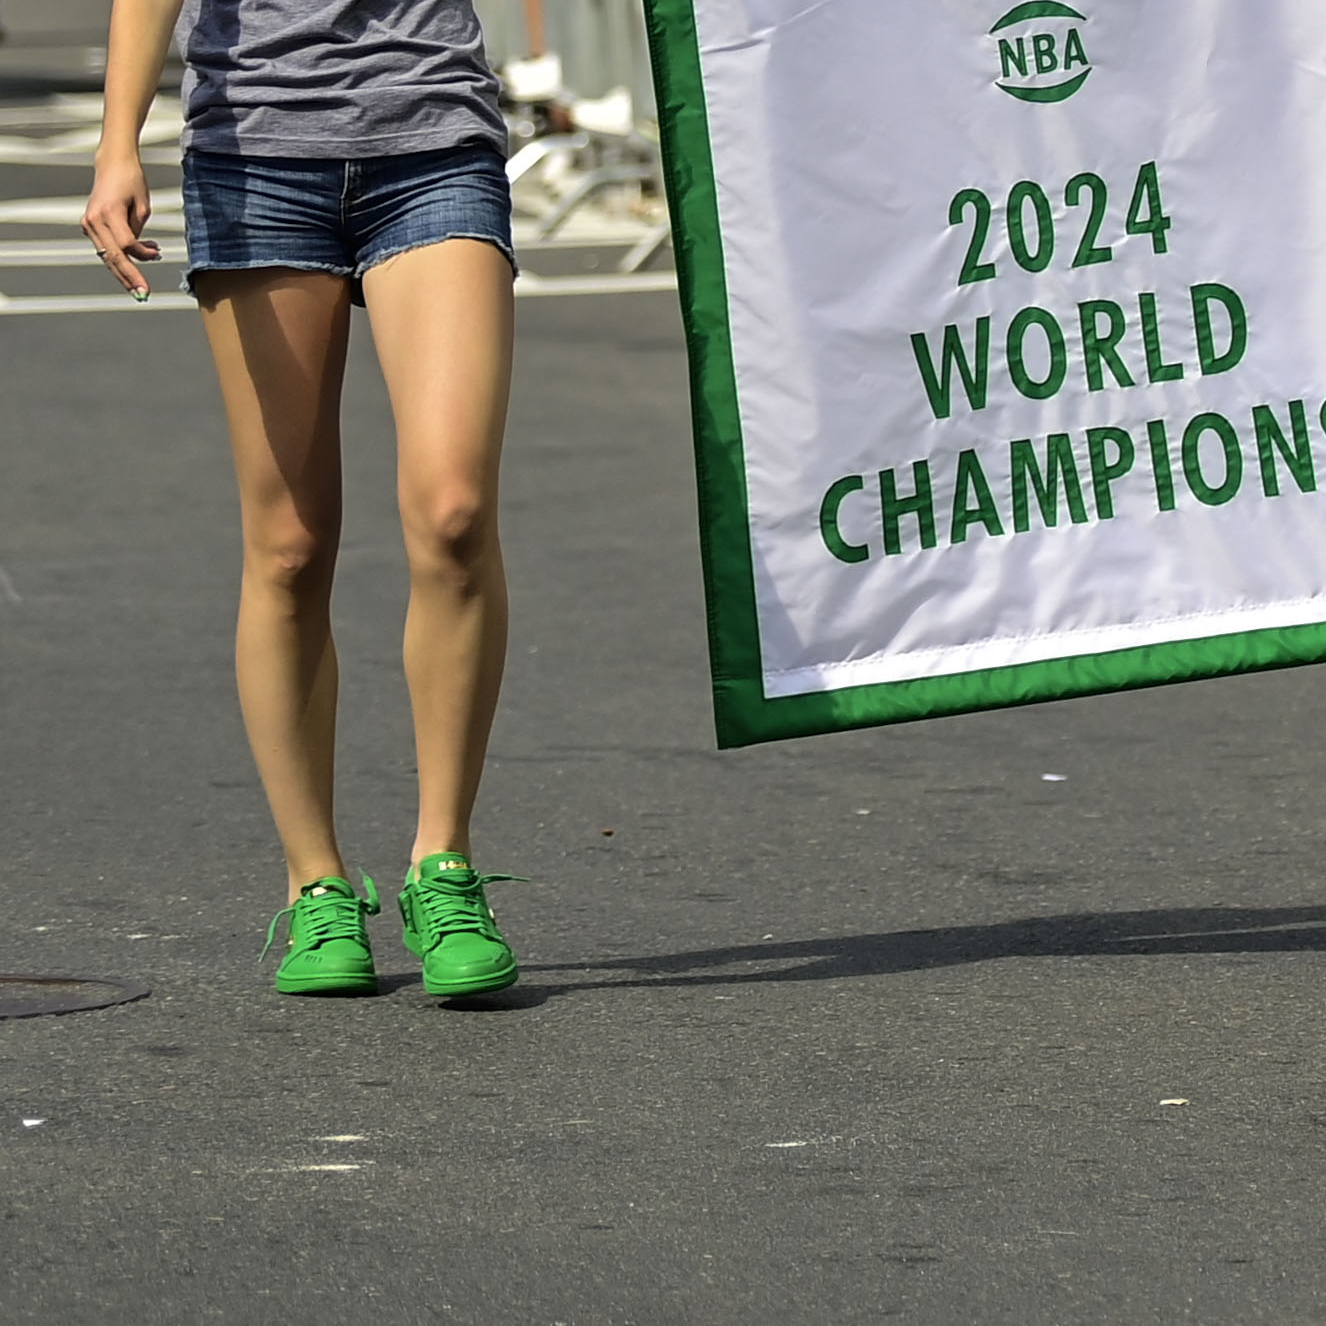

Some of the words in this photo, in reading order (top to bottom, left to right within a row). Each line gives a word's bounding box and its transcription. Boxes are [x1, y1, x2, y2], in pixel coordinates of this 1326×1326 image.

[998, 27, 1090, 78] NBA
[947, 161, 1171, 286] 2024
[910, 282, 1248, 419] WORLD
